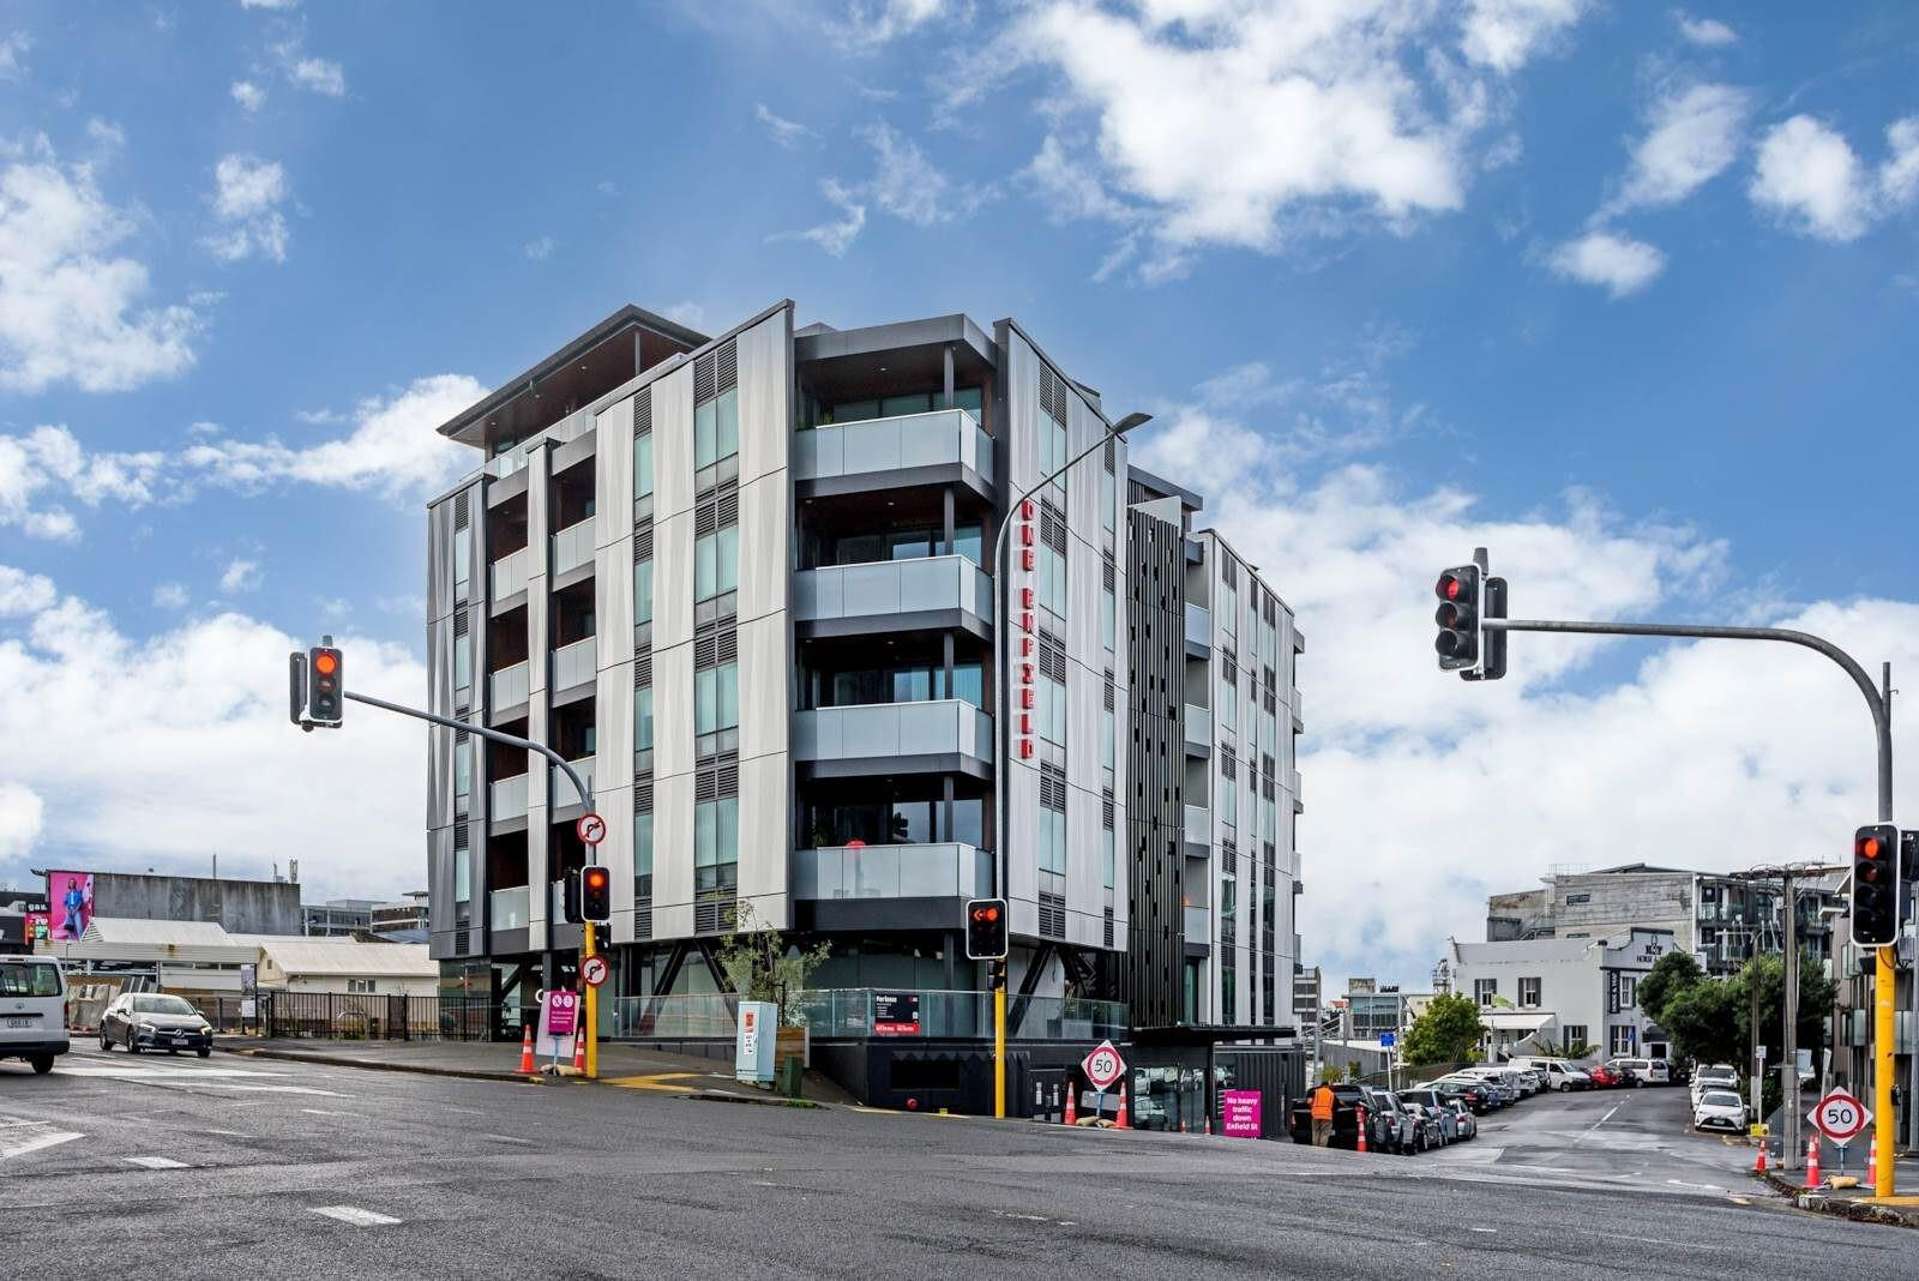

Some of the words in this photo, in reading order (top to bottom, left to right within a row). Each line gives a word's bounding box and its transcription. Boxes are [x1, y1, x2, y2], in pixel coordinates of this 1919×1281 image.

[1021, 499, 1034, 571] ONE
[1021, 588, 1034, 759] ENFIELD
[1094, 1059, 1113, 1073] 50
[1237, 1096, 1258, 1105] heavy
[1232, 1105, 1253, 1113] traffic
[1828, 1108, 1853, 1125] 50
[1226, 1122, 1250, 1130] Enfield
[1250, 1122, 1258, 1130] St
